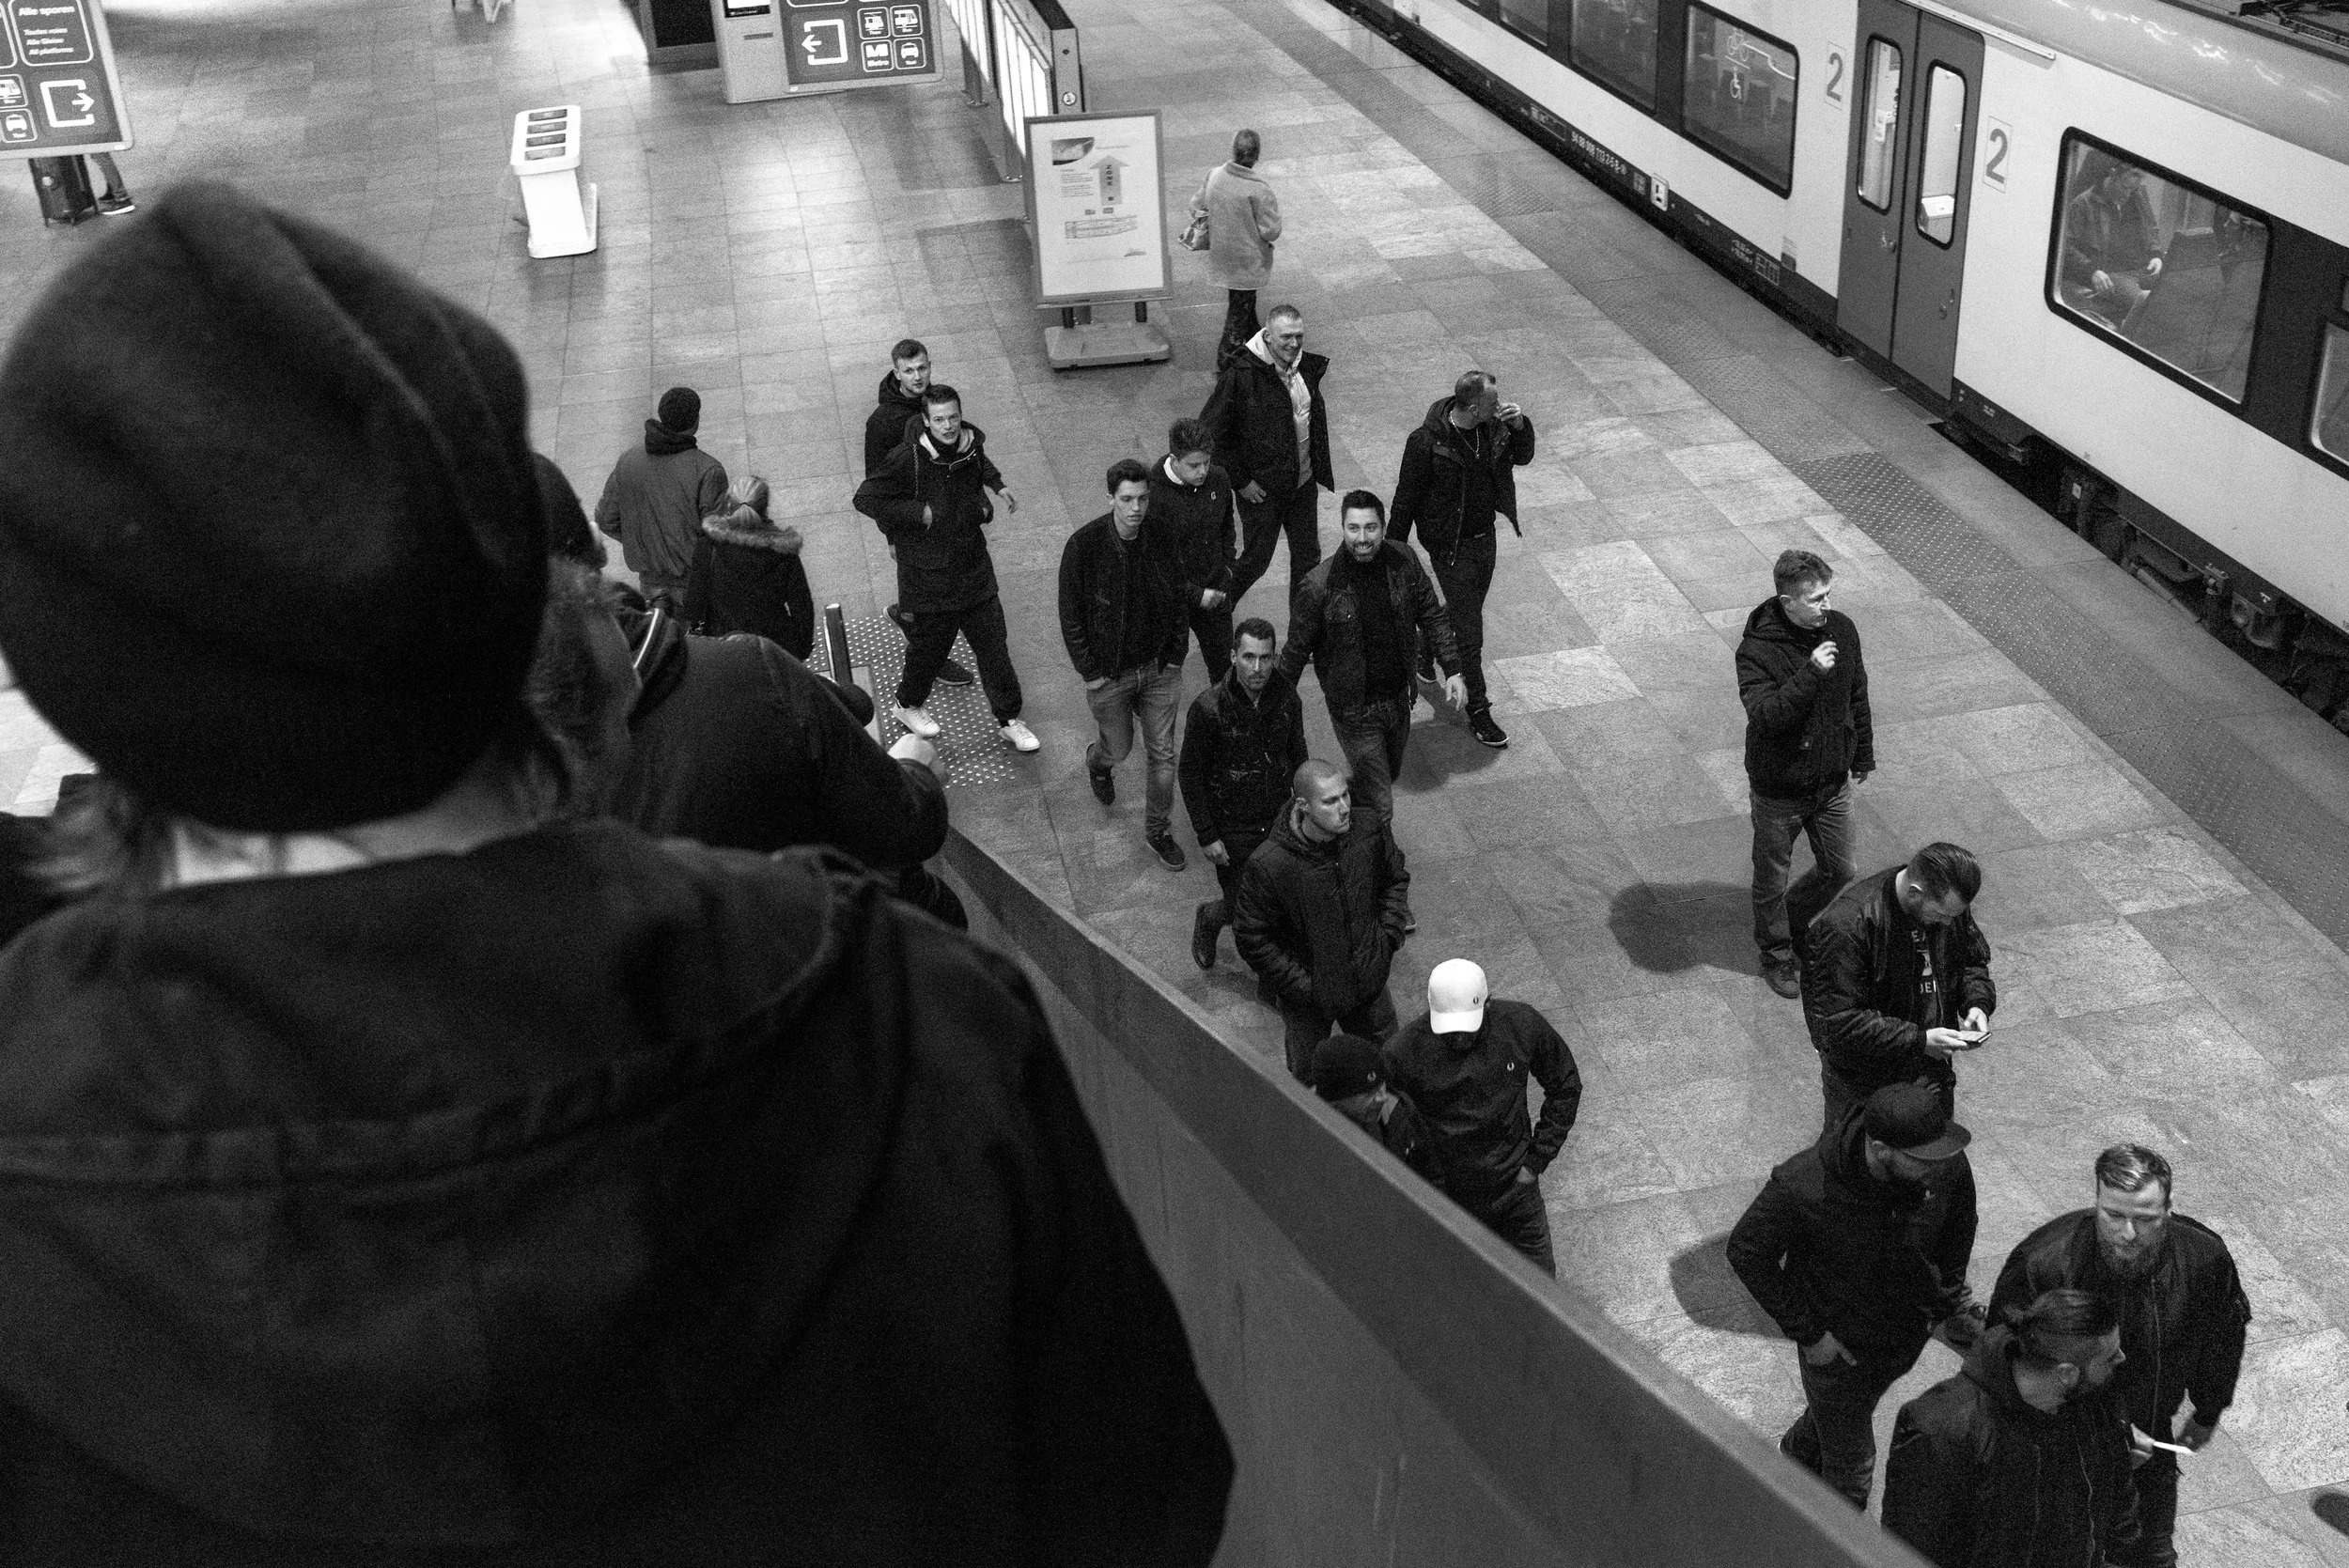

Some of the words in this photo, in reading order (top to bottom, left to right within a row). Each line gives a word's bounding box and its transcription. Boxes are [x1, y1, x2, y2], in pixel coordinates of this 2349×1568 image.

[867, 59, 890, 68] Metro
[1825, 51, 1844, 102] 2
[1985, 128, 2010, 185] 2
